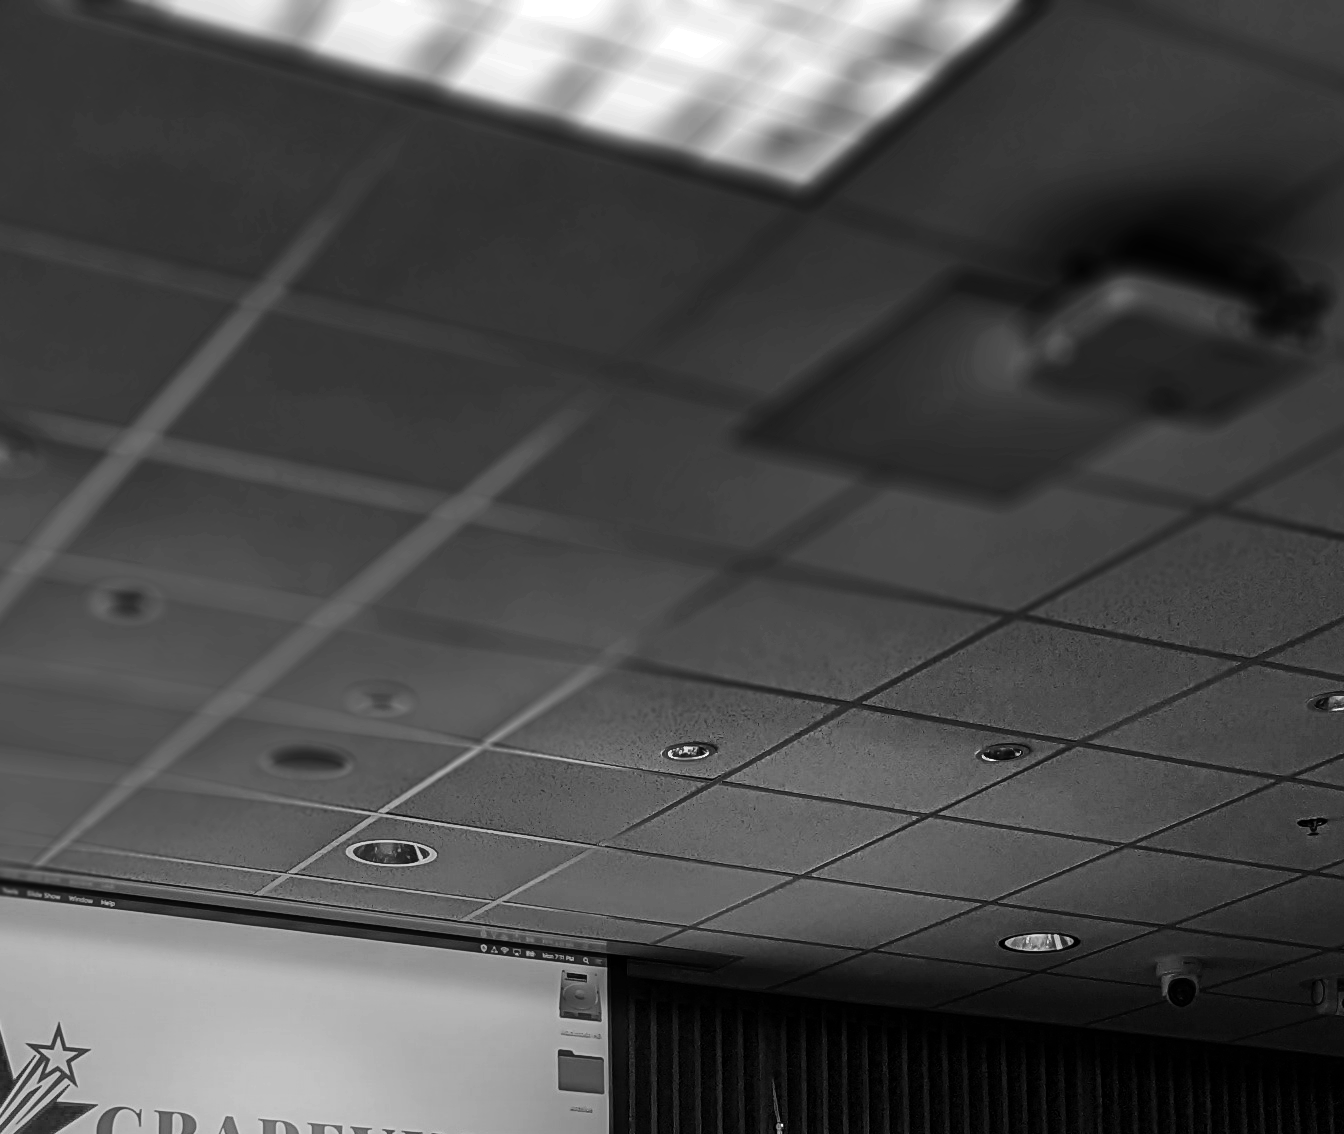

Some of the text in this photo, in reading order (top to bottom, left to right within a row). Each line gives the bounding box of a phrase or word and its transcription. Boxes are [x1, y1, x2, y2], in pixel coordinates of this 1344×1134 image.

[44, 892, 61, 900] Show
[69, 895, 93, 904] Window
[101, 899, 115, 907] Help
